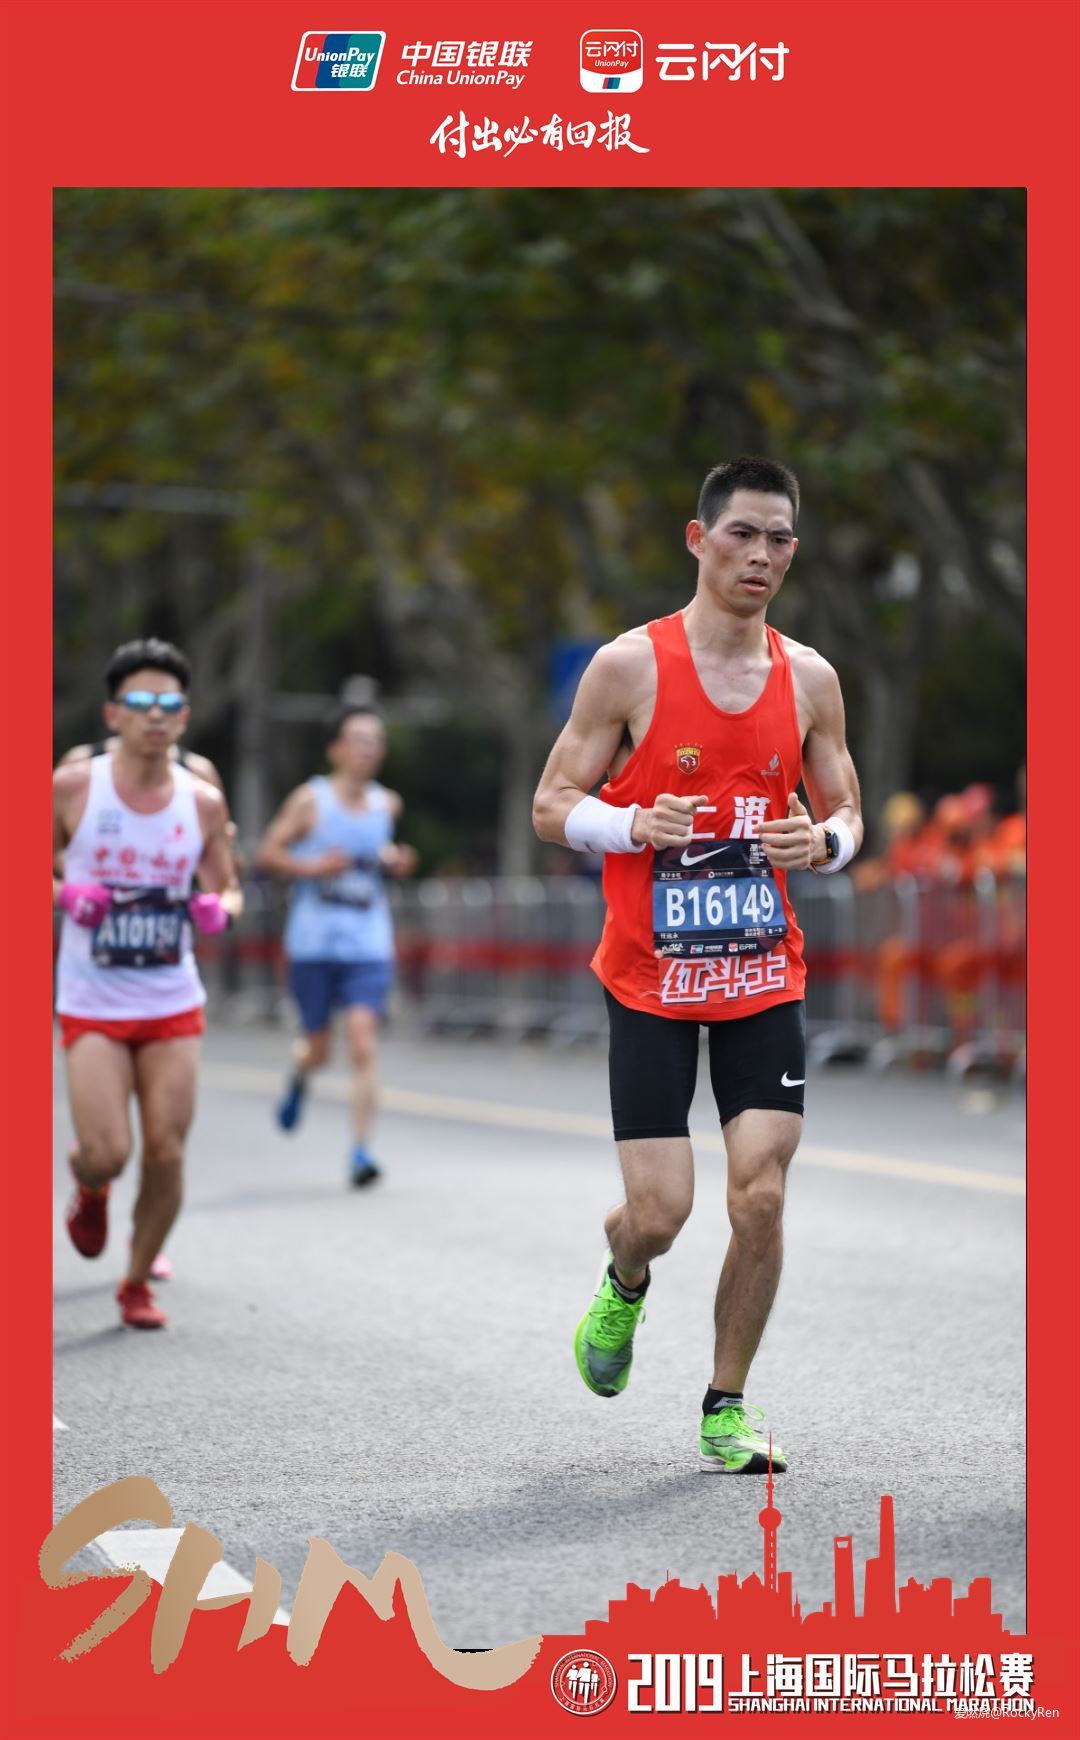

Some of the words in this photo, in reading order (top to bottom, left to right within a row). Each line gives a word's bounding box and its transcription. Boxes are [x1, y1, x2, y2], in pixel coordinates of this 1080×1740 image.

[665, 884, 775, 927] B16149
[661, 954, 786, 1004] 红斗士
